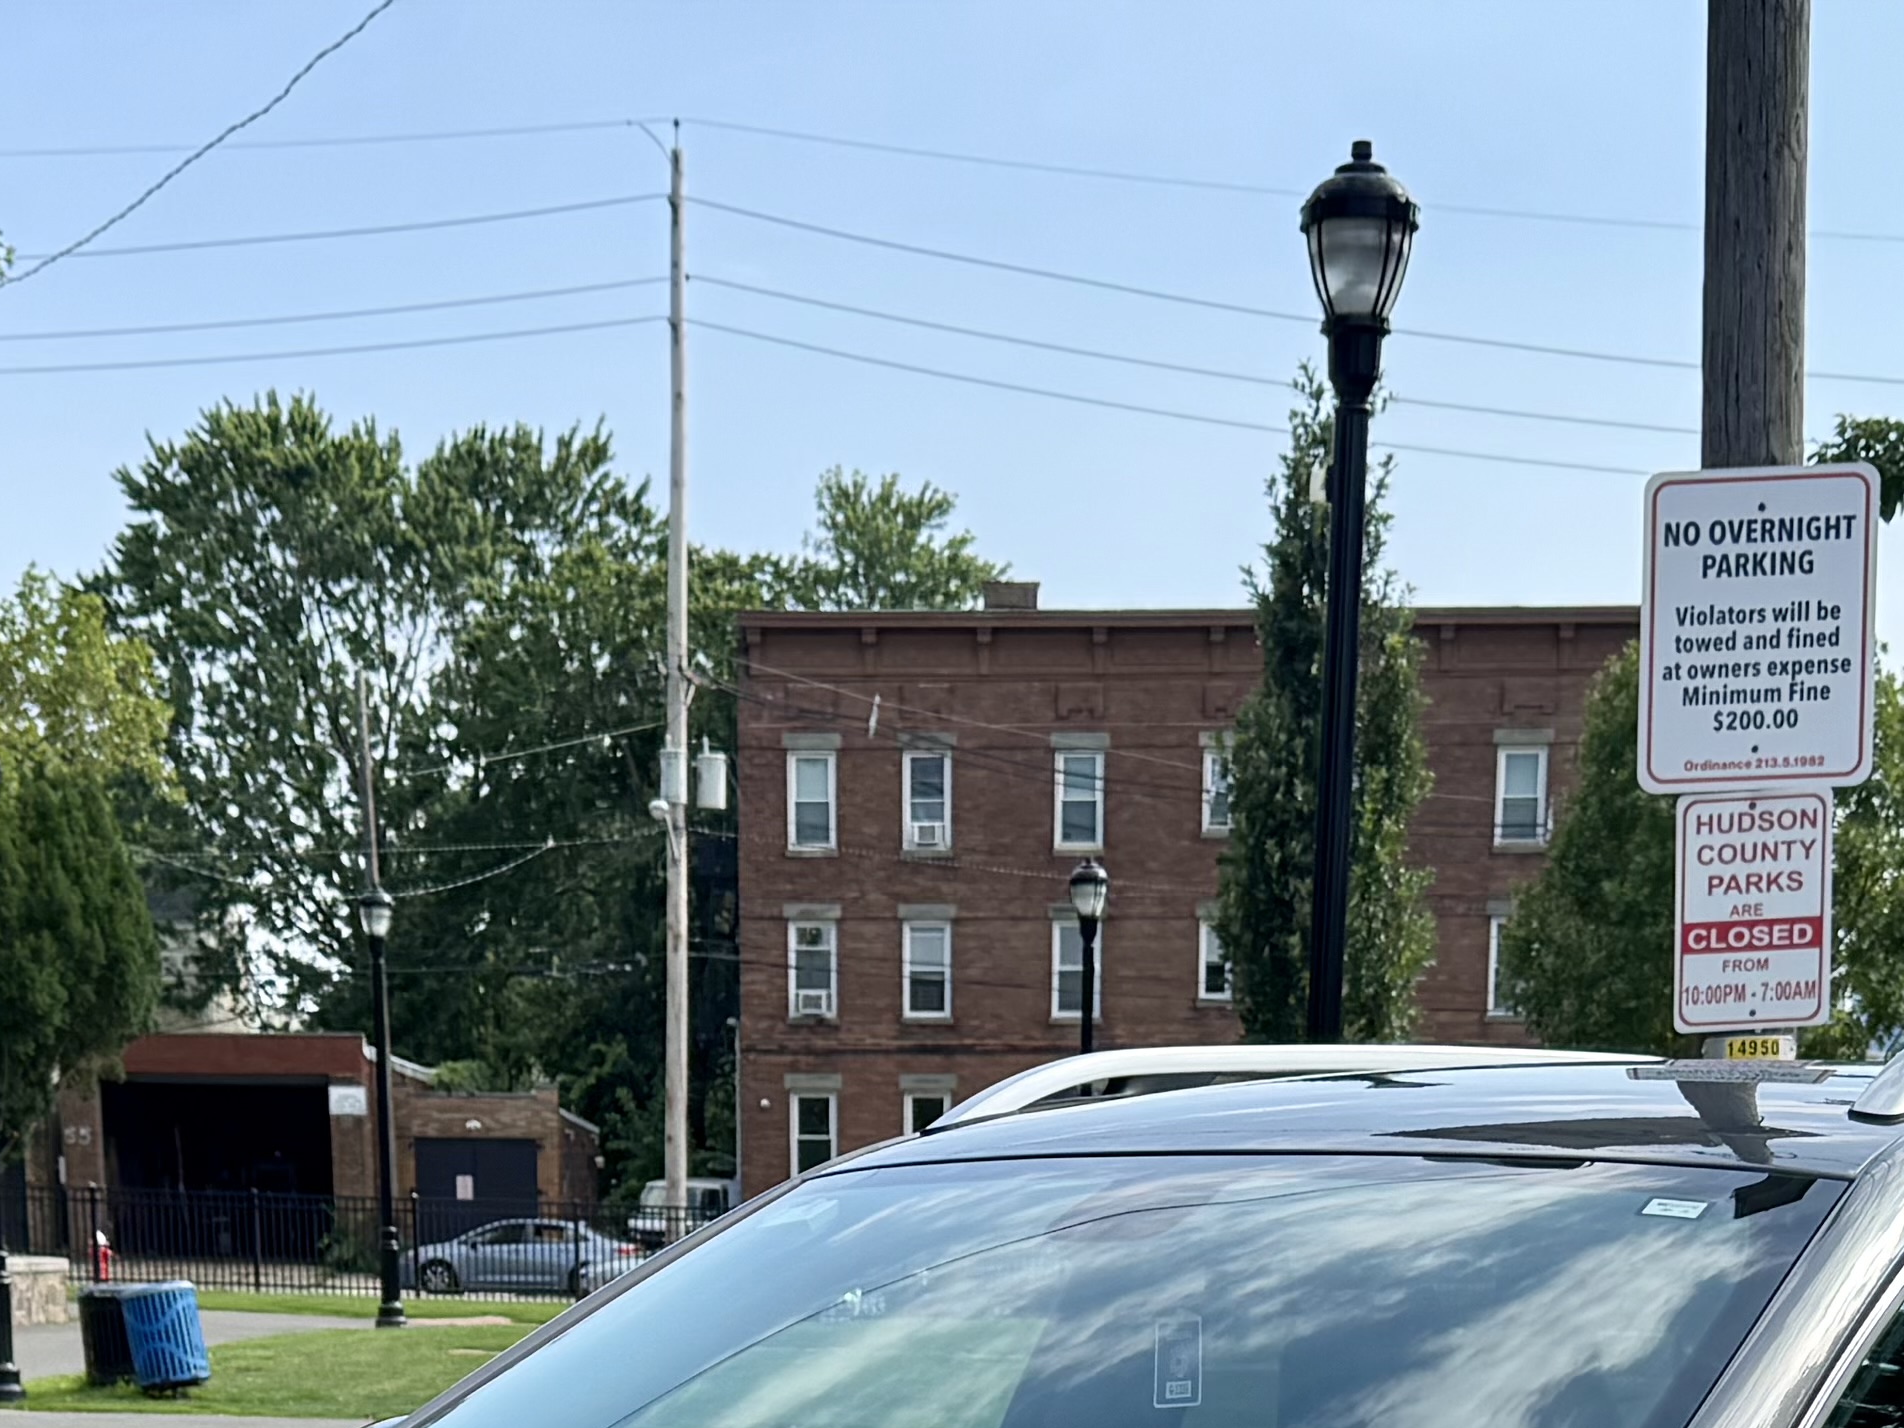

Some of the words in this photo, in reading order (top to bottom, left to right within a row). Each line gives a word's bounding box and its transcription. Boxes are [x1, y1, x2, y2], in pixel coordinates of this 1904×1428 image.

[1664, 521, 1700, 547] NO
[1709, 515, 1857, 545] OVERNIGHT
[1701, 550, 1815, 579] PARKING
[1675, 603, 1767, 627] Violators
[1772, 601, 1810, 623] will
[1817, 600, 1841, 621] be
[1674, 630, 1736, 654] towed
[1743, 628, 1781, 651] and
[1787, 625, 1840, 648] fined
[1662, 663, 1681, 681] at
[1687, 661, 1761, 680] owners
[1767, 657, 1852, 681] expense
[1682, 684, 1782, 707] Minimum
[1788, 682, 1831, 702] Fine
[1713, 708, 1799, 733] $200.00
[1684, 760, 1752, 772] Ordinance
[1696, 808, 1818, 835] HUDSON
[1696, 839, 1817, 866] COUNTY
[1707, 871, 1804, 896] PARKS
[1729, 903, 1764, 918] ARE
[1687, 923, 1813, 950] CLOSED
[1722, 958, 1770, 973] FROM
[1684, 983, 1746, 1006] 10:00PM
[1761, 980, 1817, 1001] 7:00AM
[1728, 1040, 1780, 1057] 14950
